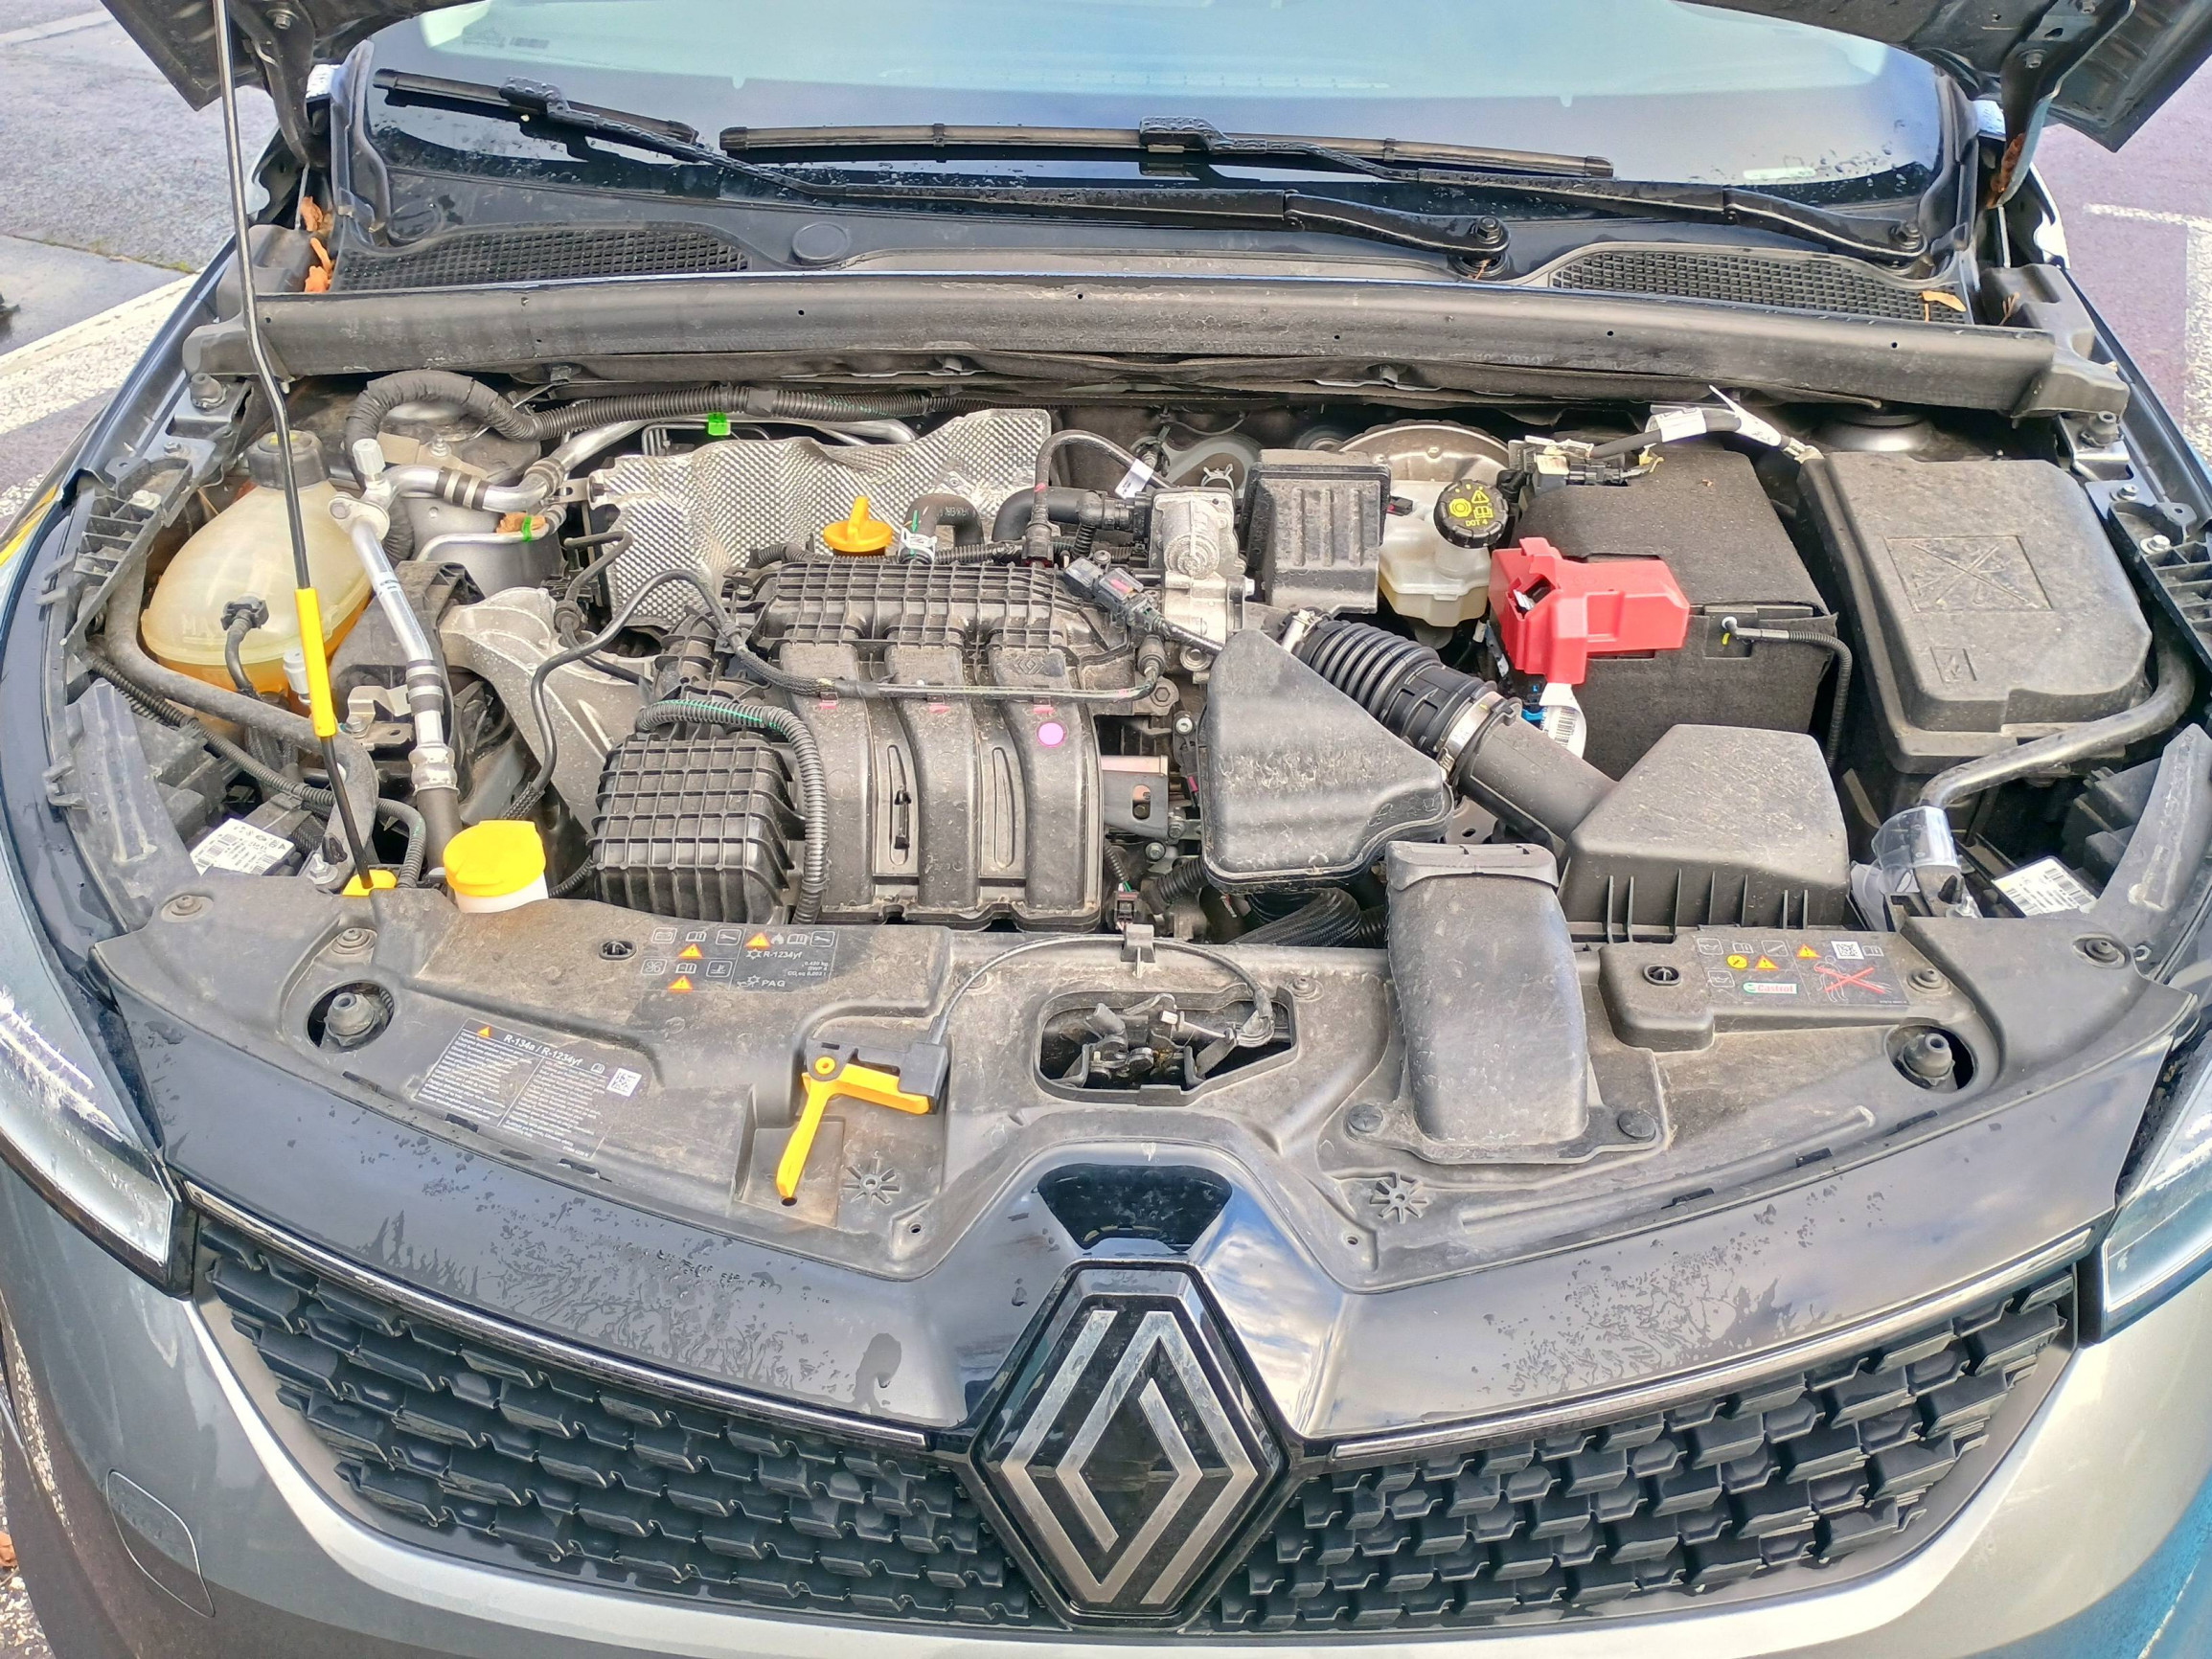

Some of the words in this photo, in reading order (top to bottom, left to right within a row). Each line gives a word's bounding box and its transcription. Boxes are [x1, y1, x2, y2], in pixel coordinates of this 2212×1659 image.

[763, 950, 804, 960] R-1234yf
[762, 979, 787, 988] PAG
[1757, 984, 1794, 993] Castrol
[504, 1034, 536, 1053] R-134a
[540, 1047, 584, 1065] R-1234yf
